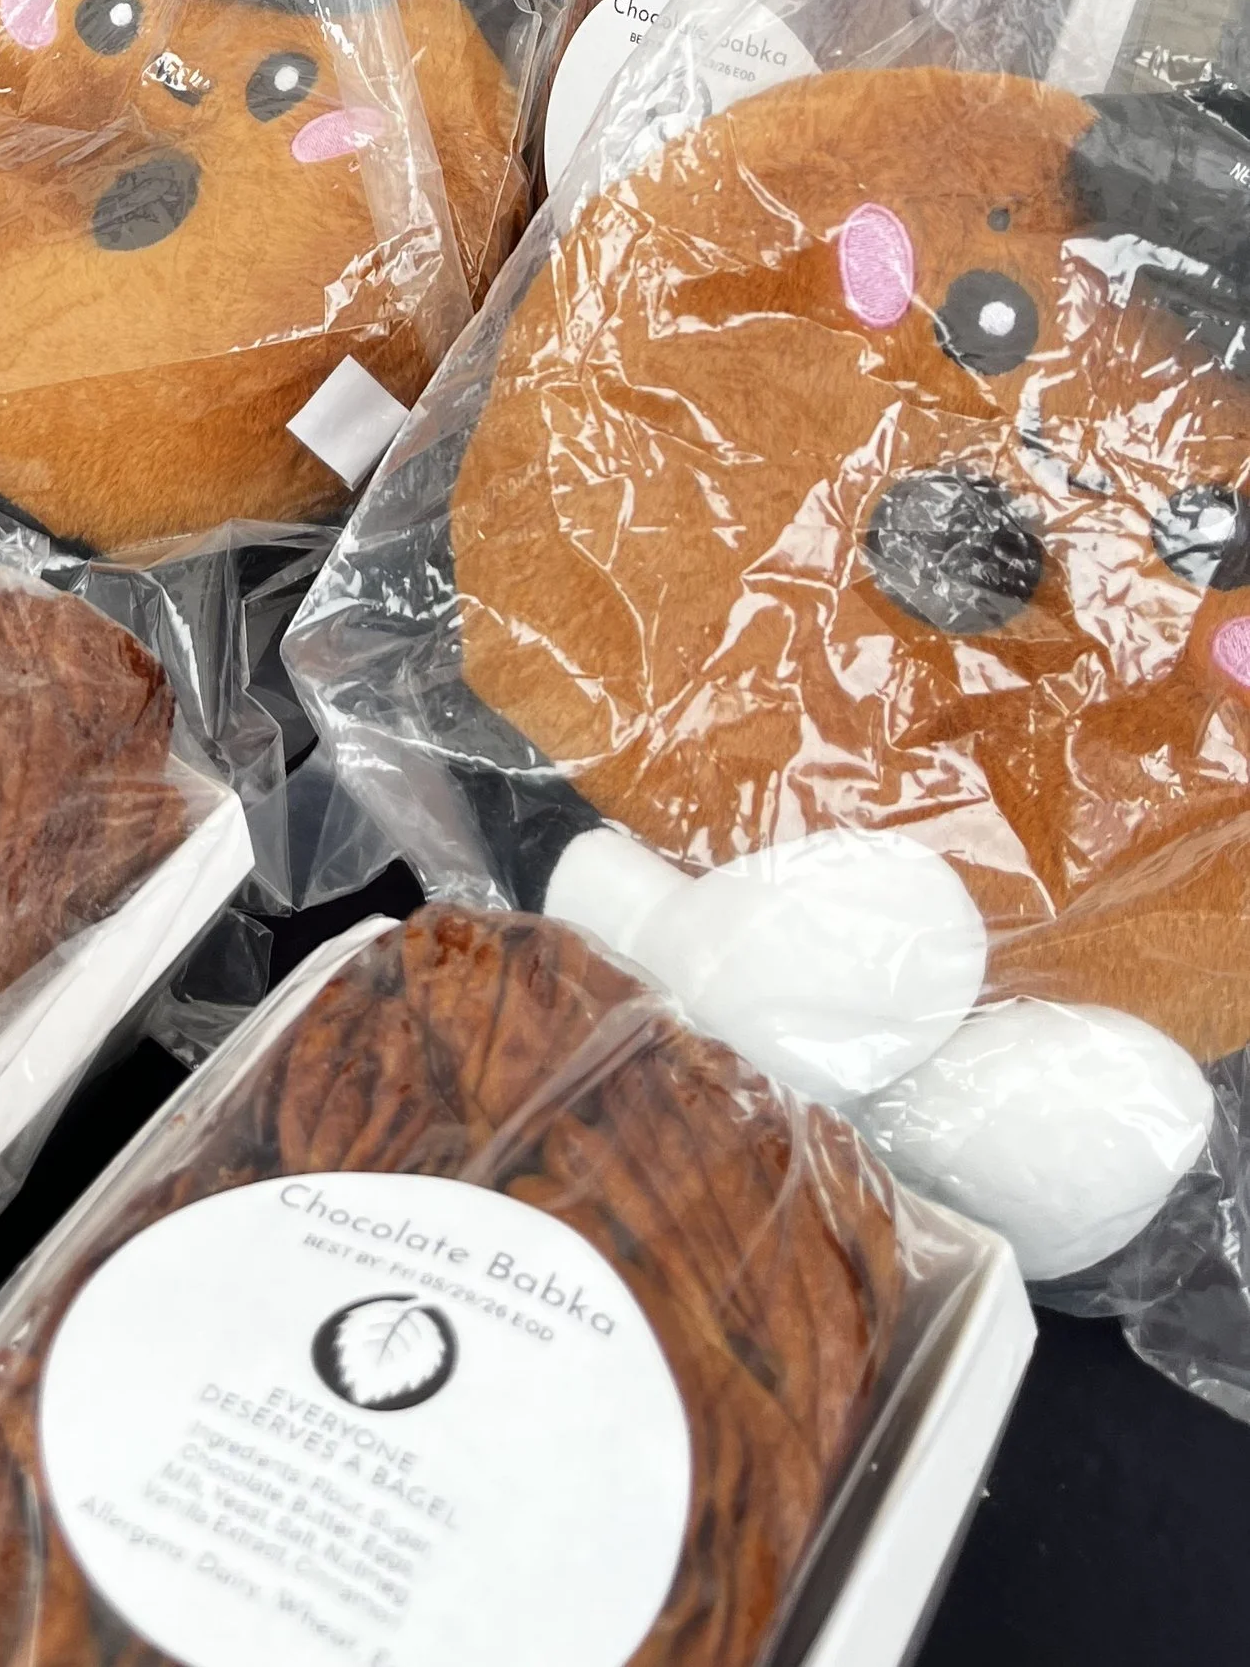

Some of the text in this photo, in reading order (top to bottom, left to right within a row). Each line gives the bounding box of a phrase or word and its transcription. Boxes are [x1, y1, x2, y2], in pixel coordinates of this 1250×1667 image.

[279, 1183, 617, 1338] Chocolate Babka
[302, 1231, 353, 1261] BEST
[388, 1259, 418, 1282] Fri
[510, 1310, 556, 1343] EOD
[198, 1381, 463, 1533] DESERVES A BAGEL
[266, 1385, 419, 1476] EVERYONE
